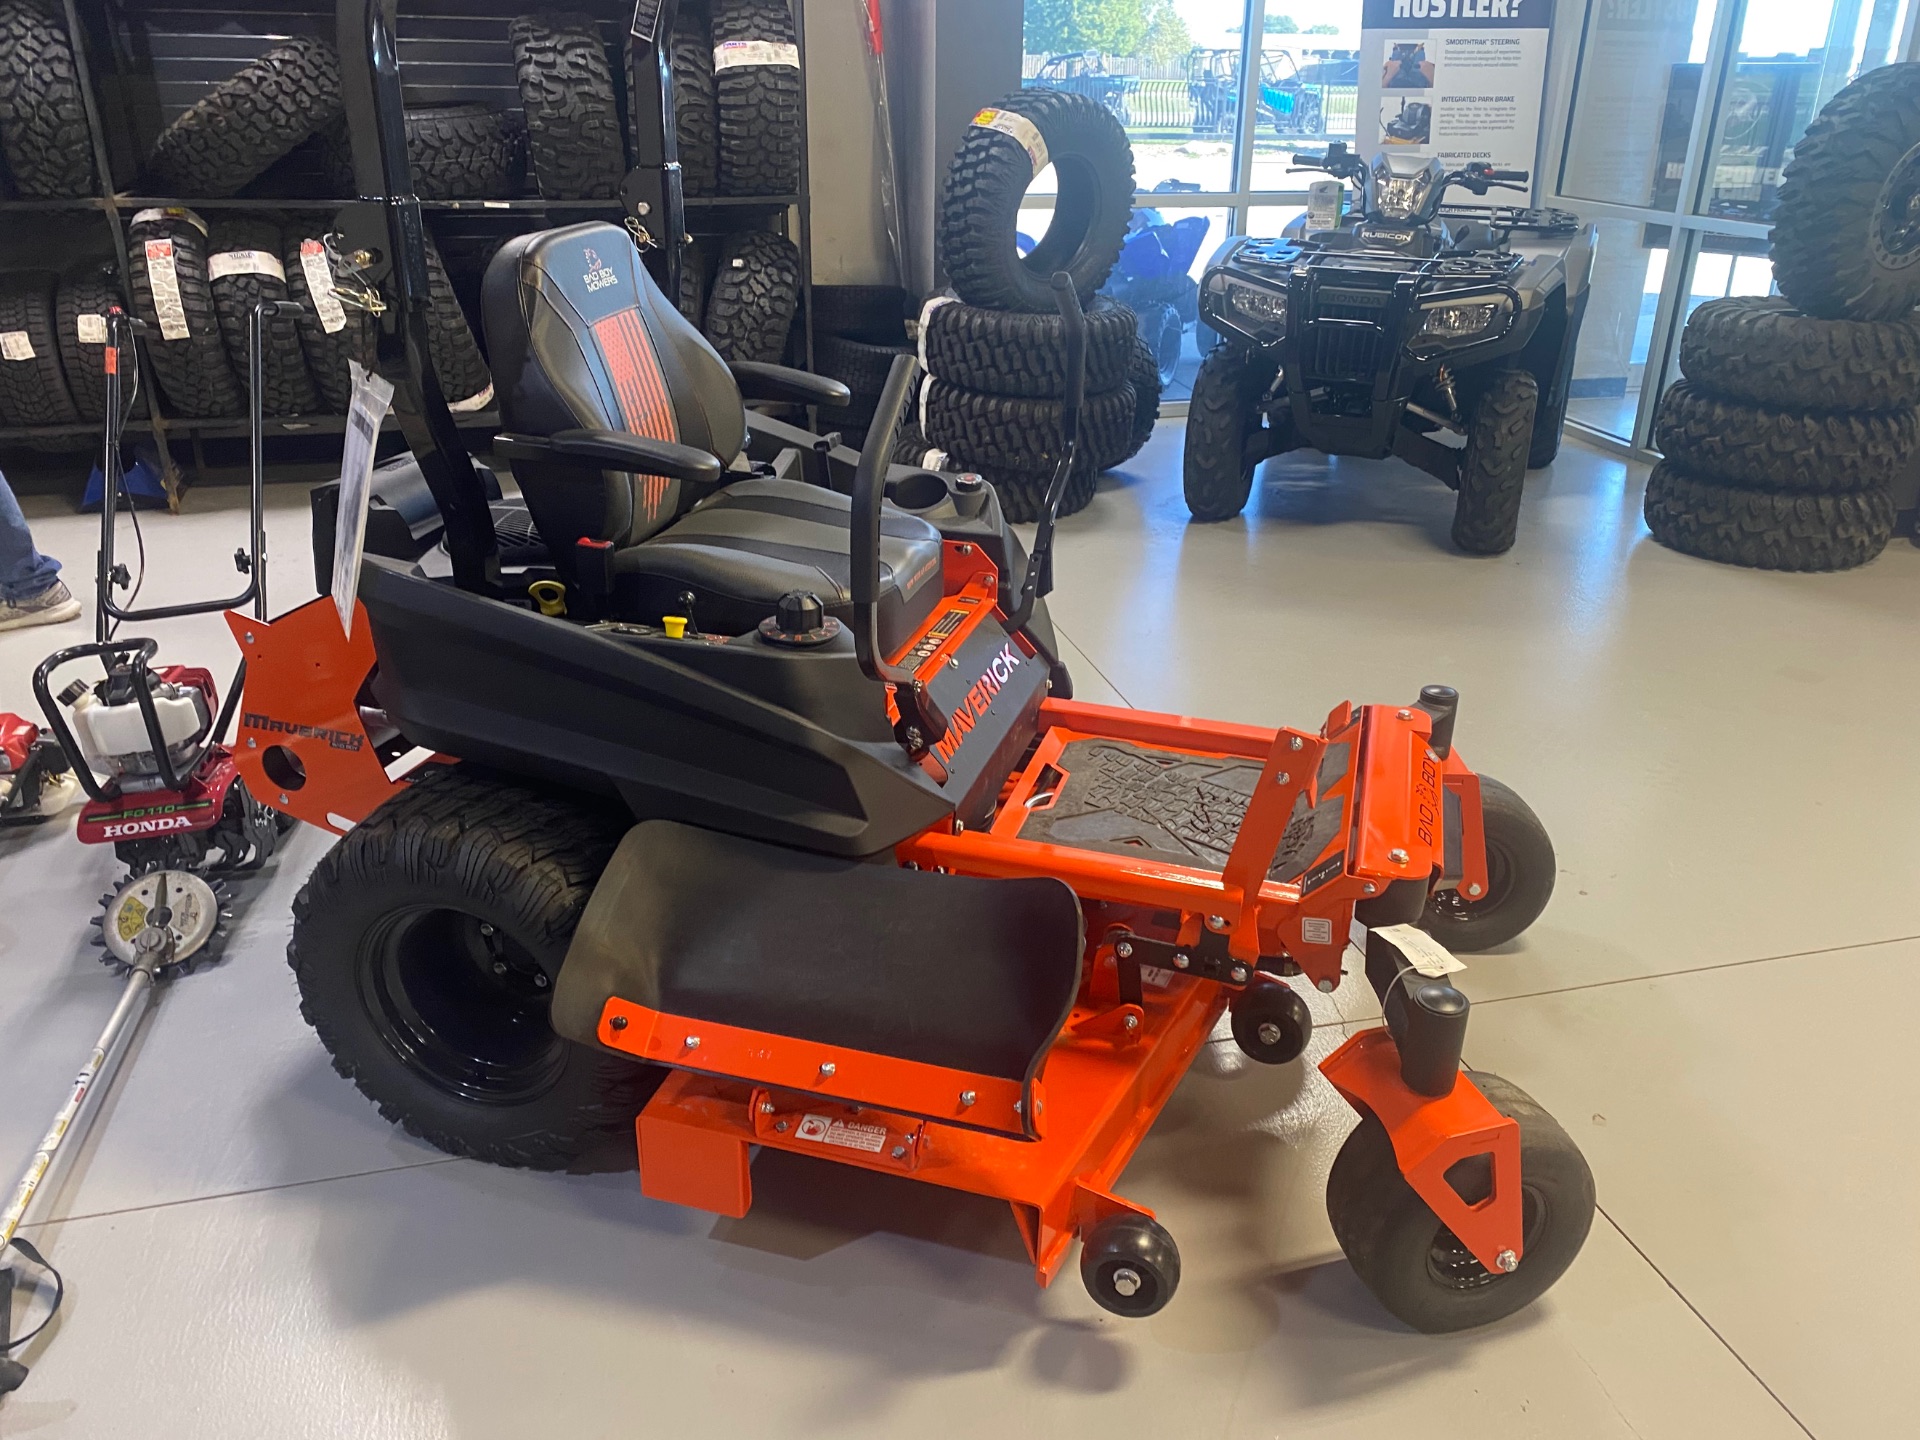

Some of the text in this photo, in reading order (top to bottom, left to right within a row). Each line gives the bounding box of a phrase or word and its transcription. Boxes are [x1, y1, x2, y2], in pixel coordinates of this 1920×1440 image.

[1393, 0, 1522, 18] HUSTLER?
[1361, 231, 1411, 241] RUBICON
[583, 266, 613, 284] BAD BOY
[586, 275, 619, 293] MOWERS
[1327, 293, 1381, 304] HONDA
[935, 642, 1021, 764] MAVERICK
[1418, 749, 1437, 847] BAD BOY
[103, 816, 192, 838] HONDA
[847, 1121, 887, 1135] DANGER
